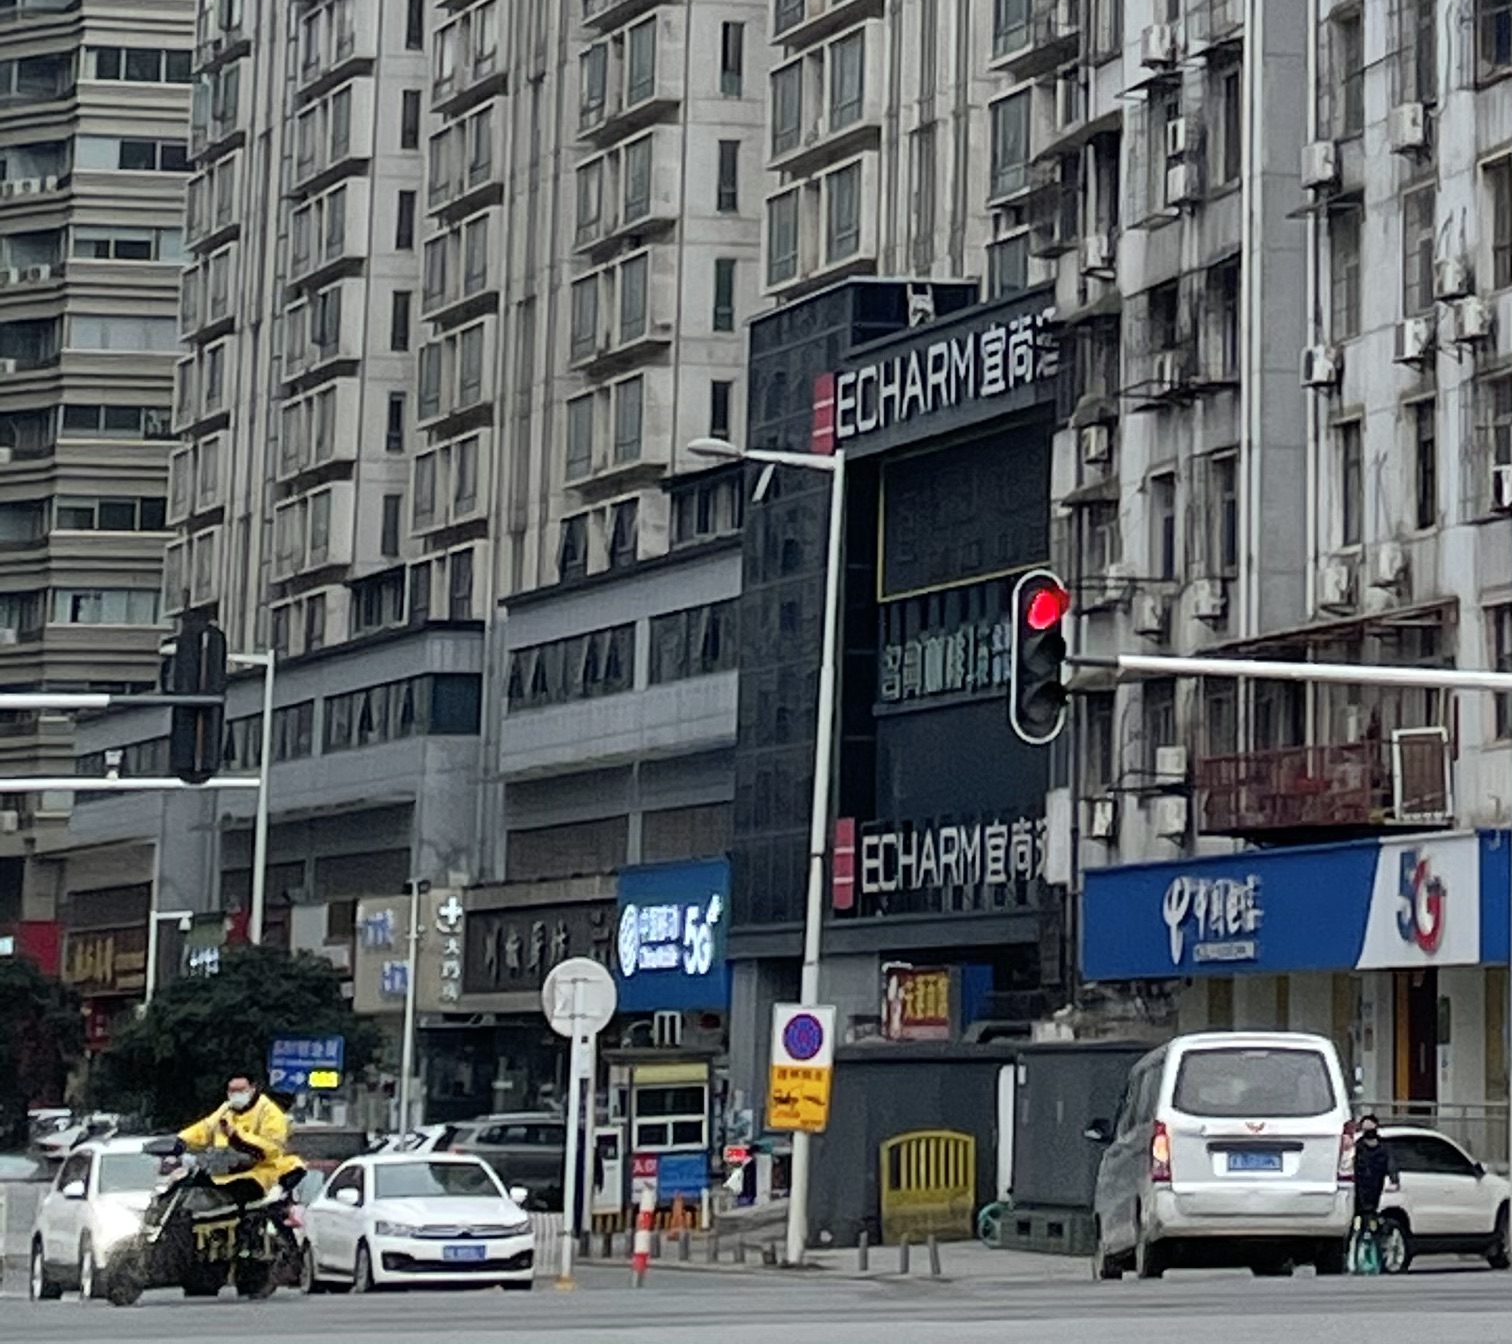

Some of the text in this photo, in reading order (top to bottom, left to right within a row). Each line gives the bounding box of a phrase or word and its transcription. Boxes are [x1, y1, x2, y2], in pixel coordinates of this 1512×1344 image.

[836, 331, 975, 439] ECHARM
[862, 823, 981, 894] ECHARM
[1396, 849, 1447, 956] 5G
